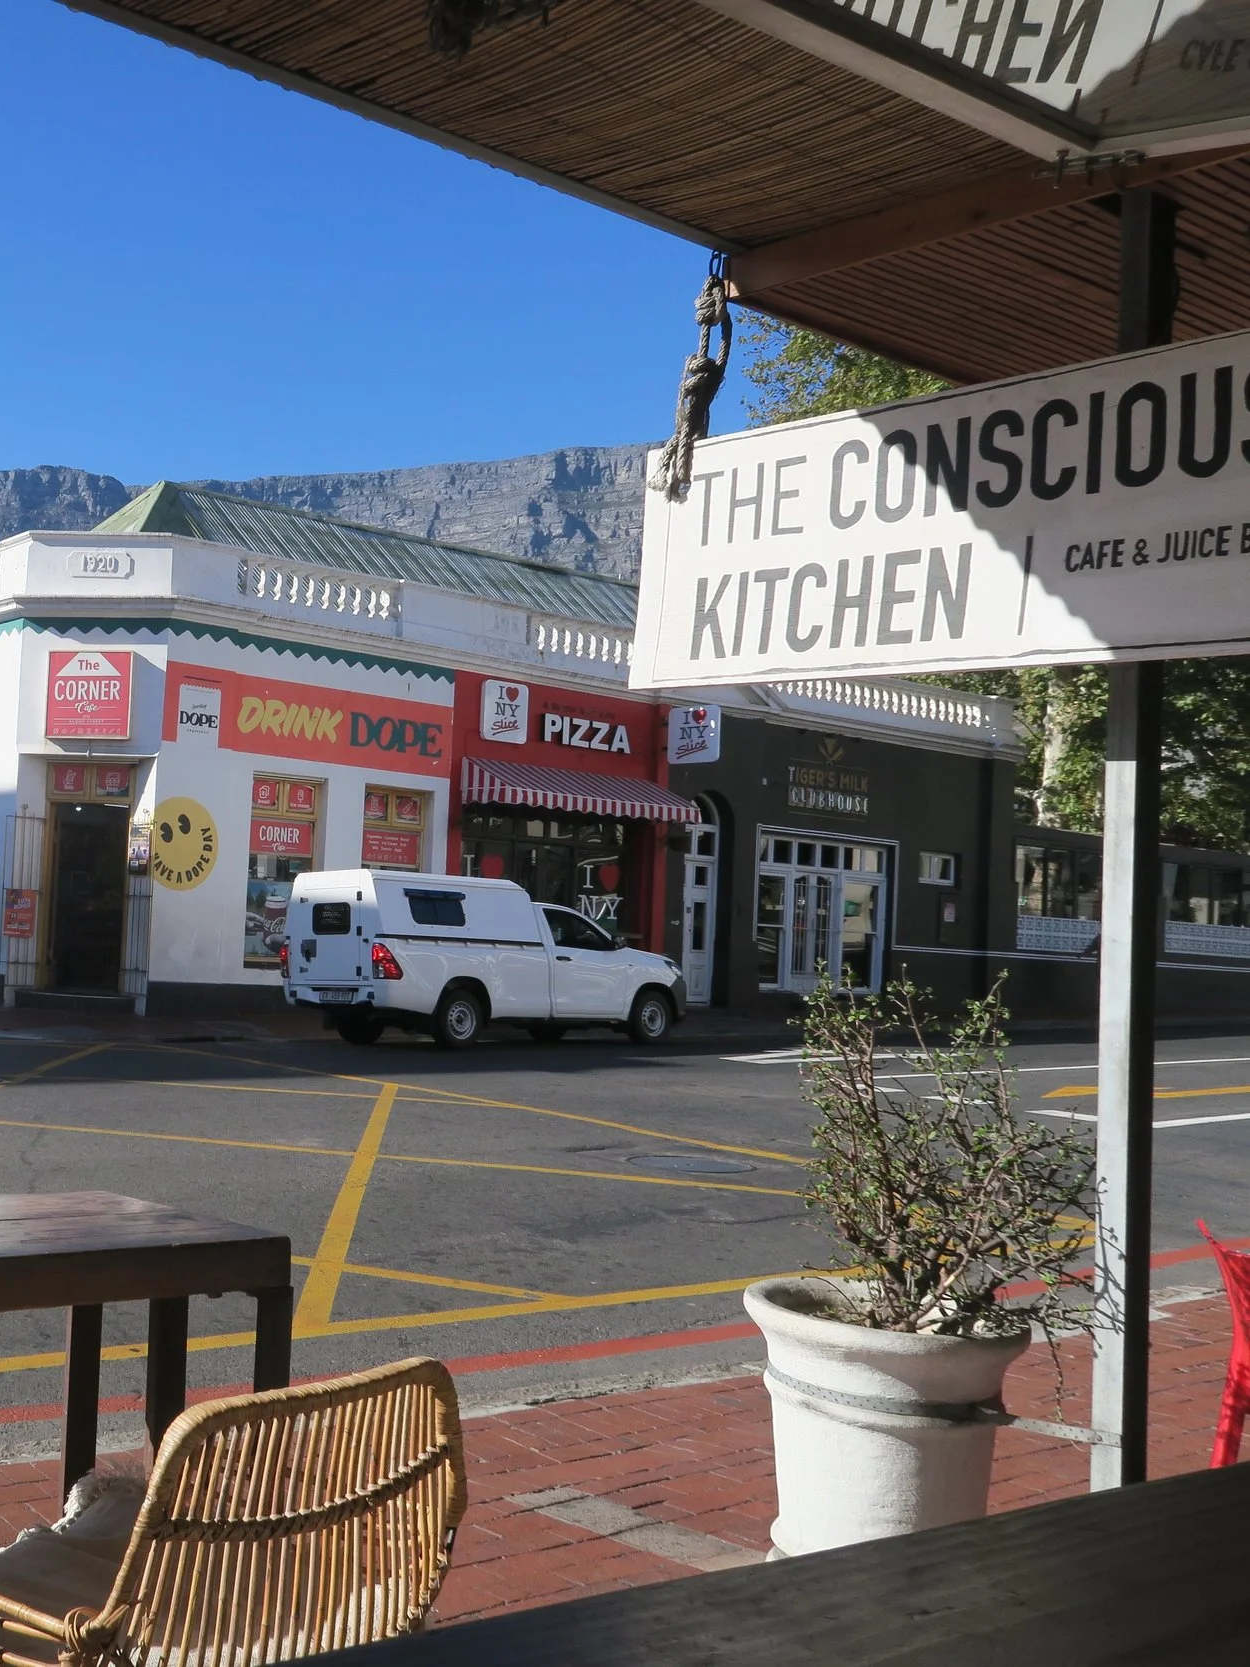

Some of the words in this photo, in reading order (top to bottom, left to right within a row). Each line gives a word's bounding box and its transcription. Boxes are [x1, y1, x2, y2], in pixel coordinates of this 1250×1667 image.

[692, 454, 808, 547] THE
[1065, 539, 1125, 572] CAFE
[1132, 538, 1149, 566] &
[1156, 525, 1232, 563] JUICE
[80, 553, 117, 571] 1920
[690, 543, 973, 661] KITCHEN
[78, 659, 100, 671] The
[54, 680, 121, 701] CORNER
[498, 686, 505, 700] I
[180, 711, 218, 729] DOPE
[494, 702, 521, 718] NY
[682, 711, 691, 725] I
[237, 696, 344, 744] DRINK
[350, 712, 443, 758] DOPE
[543, 713, 631, 754] PIZZA
[679, 725, 709, 740] NY
[840, 772, 869, 793] MILK
[792, 787, 869, 814] CLUBHOUSE
[259, 825, 299, 843] CORNER
[185, 854, 210, 882] DOPE
[201, 827, 213, 852] DAY
[578, 894, 624, 920] NY
